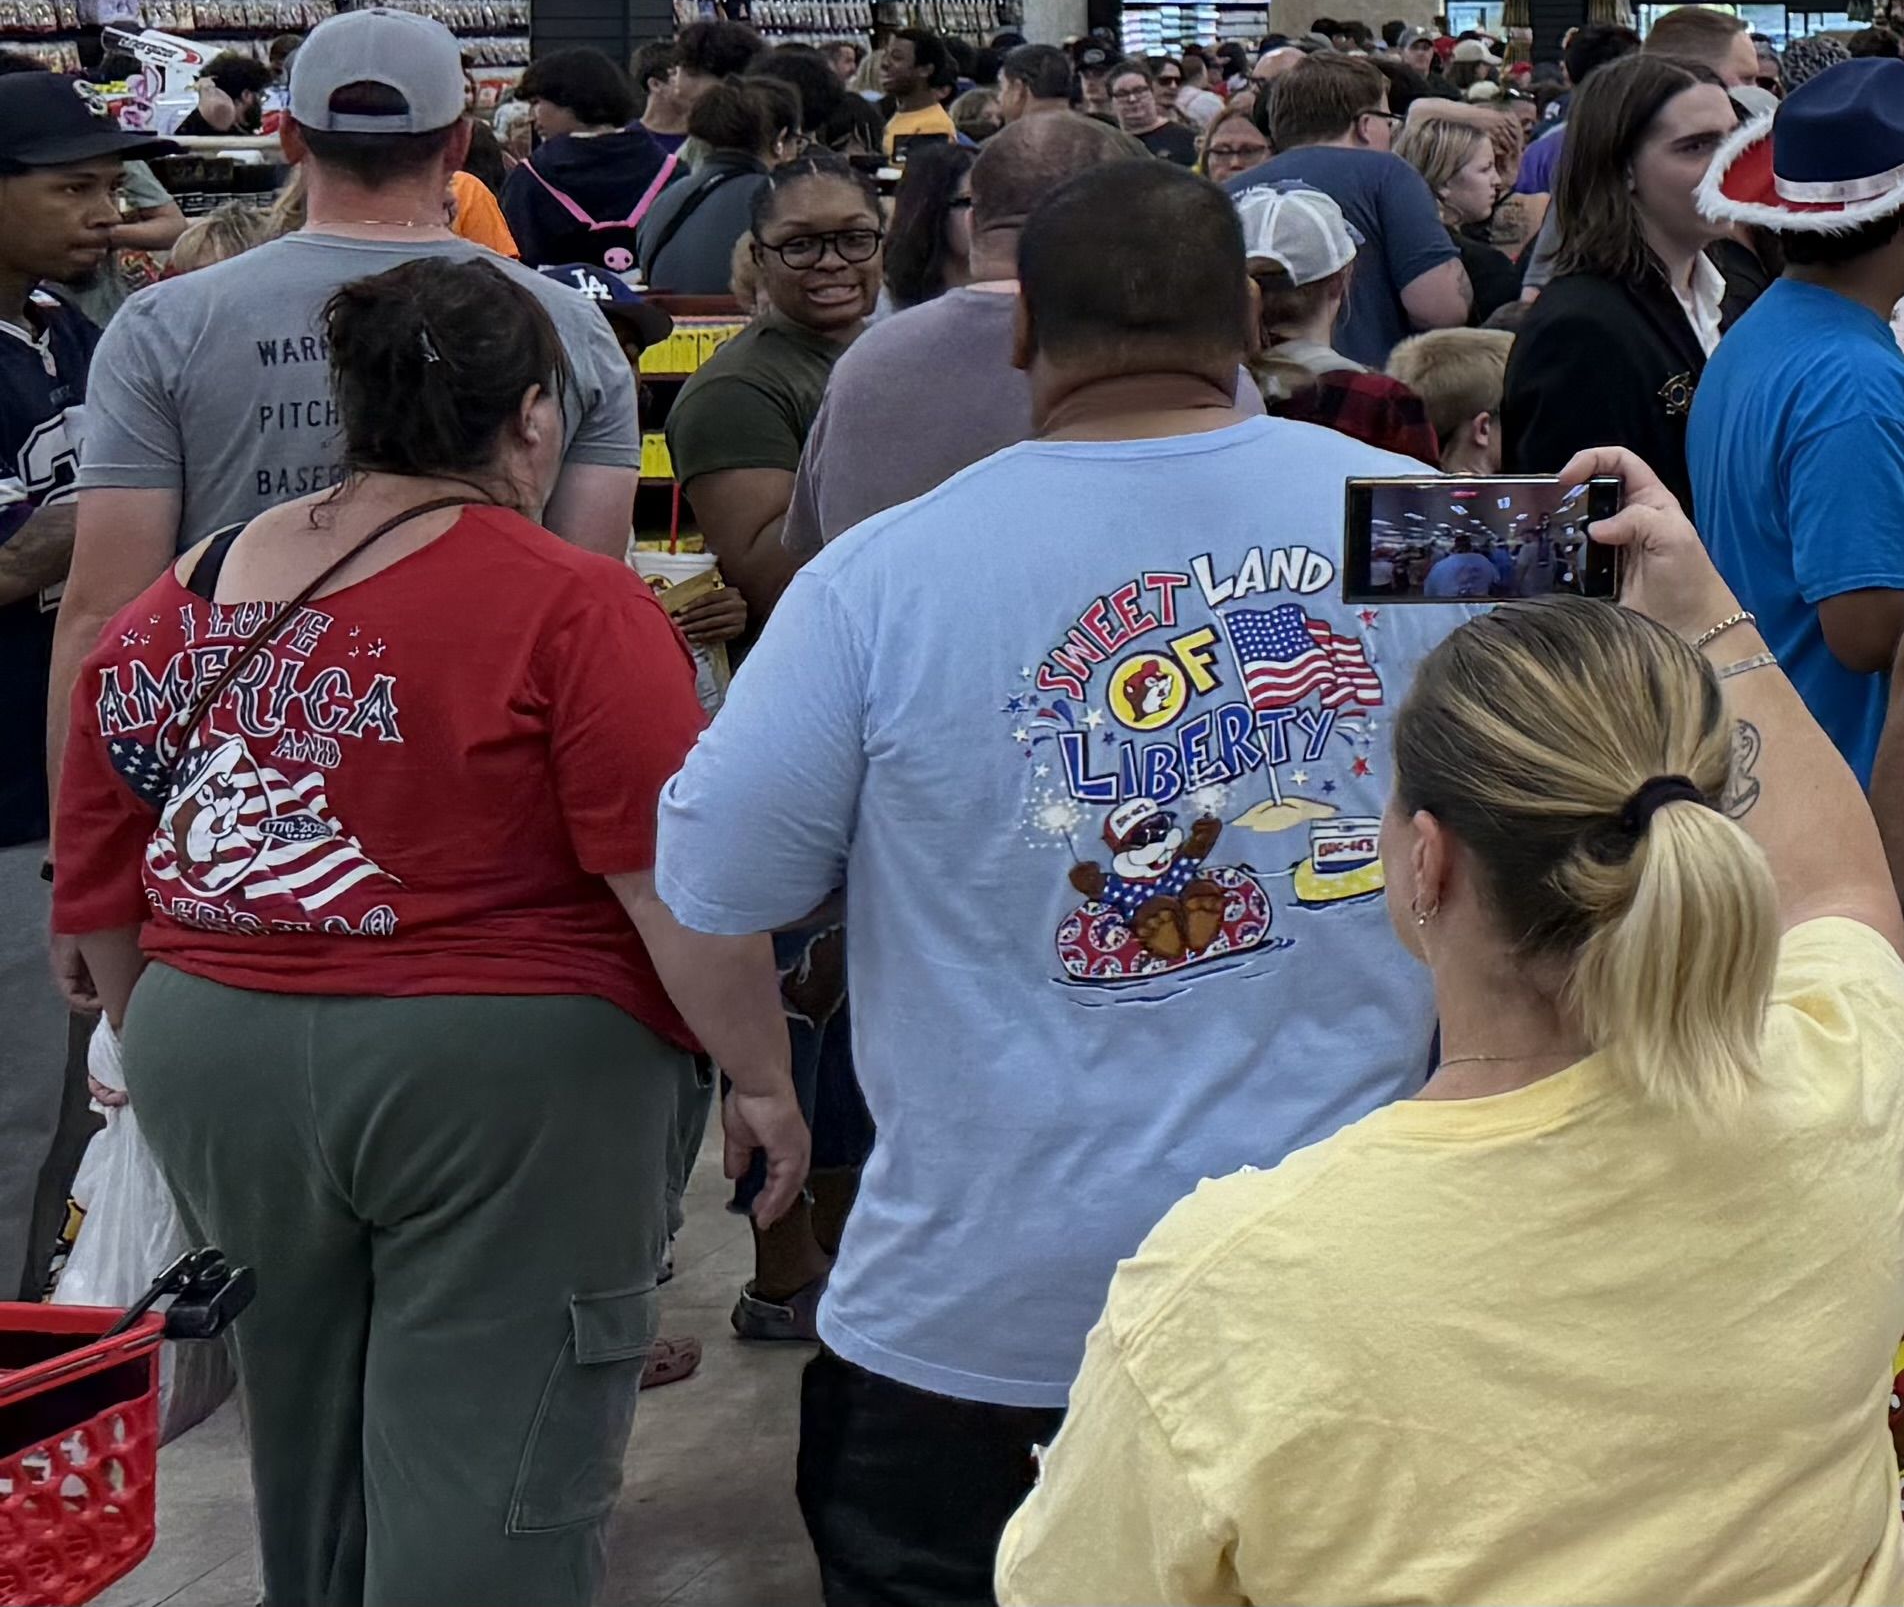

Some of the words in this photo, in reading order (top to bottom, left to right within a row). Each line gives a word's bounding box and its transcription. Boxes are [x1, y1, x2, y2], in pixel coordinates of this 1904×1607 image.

[570, 267, 613, 301] LA
[179, 602, 197, 646] I
[205, 600, 334, 657] LOVE
[1035, 570, 1190, 704] SWEET
[1190, 545, 1336, 609] LAND
[96, 645, 404, 743] AMERICA
[270, 728, 342, 769] AND
[1057, 700, 1338, 806] LIBERTY
